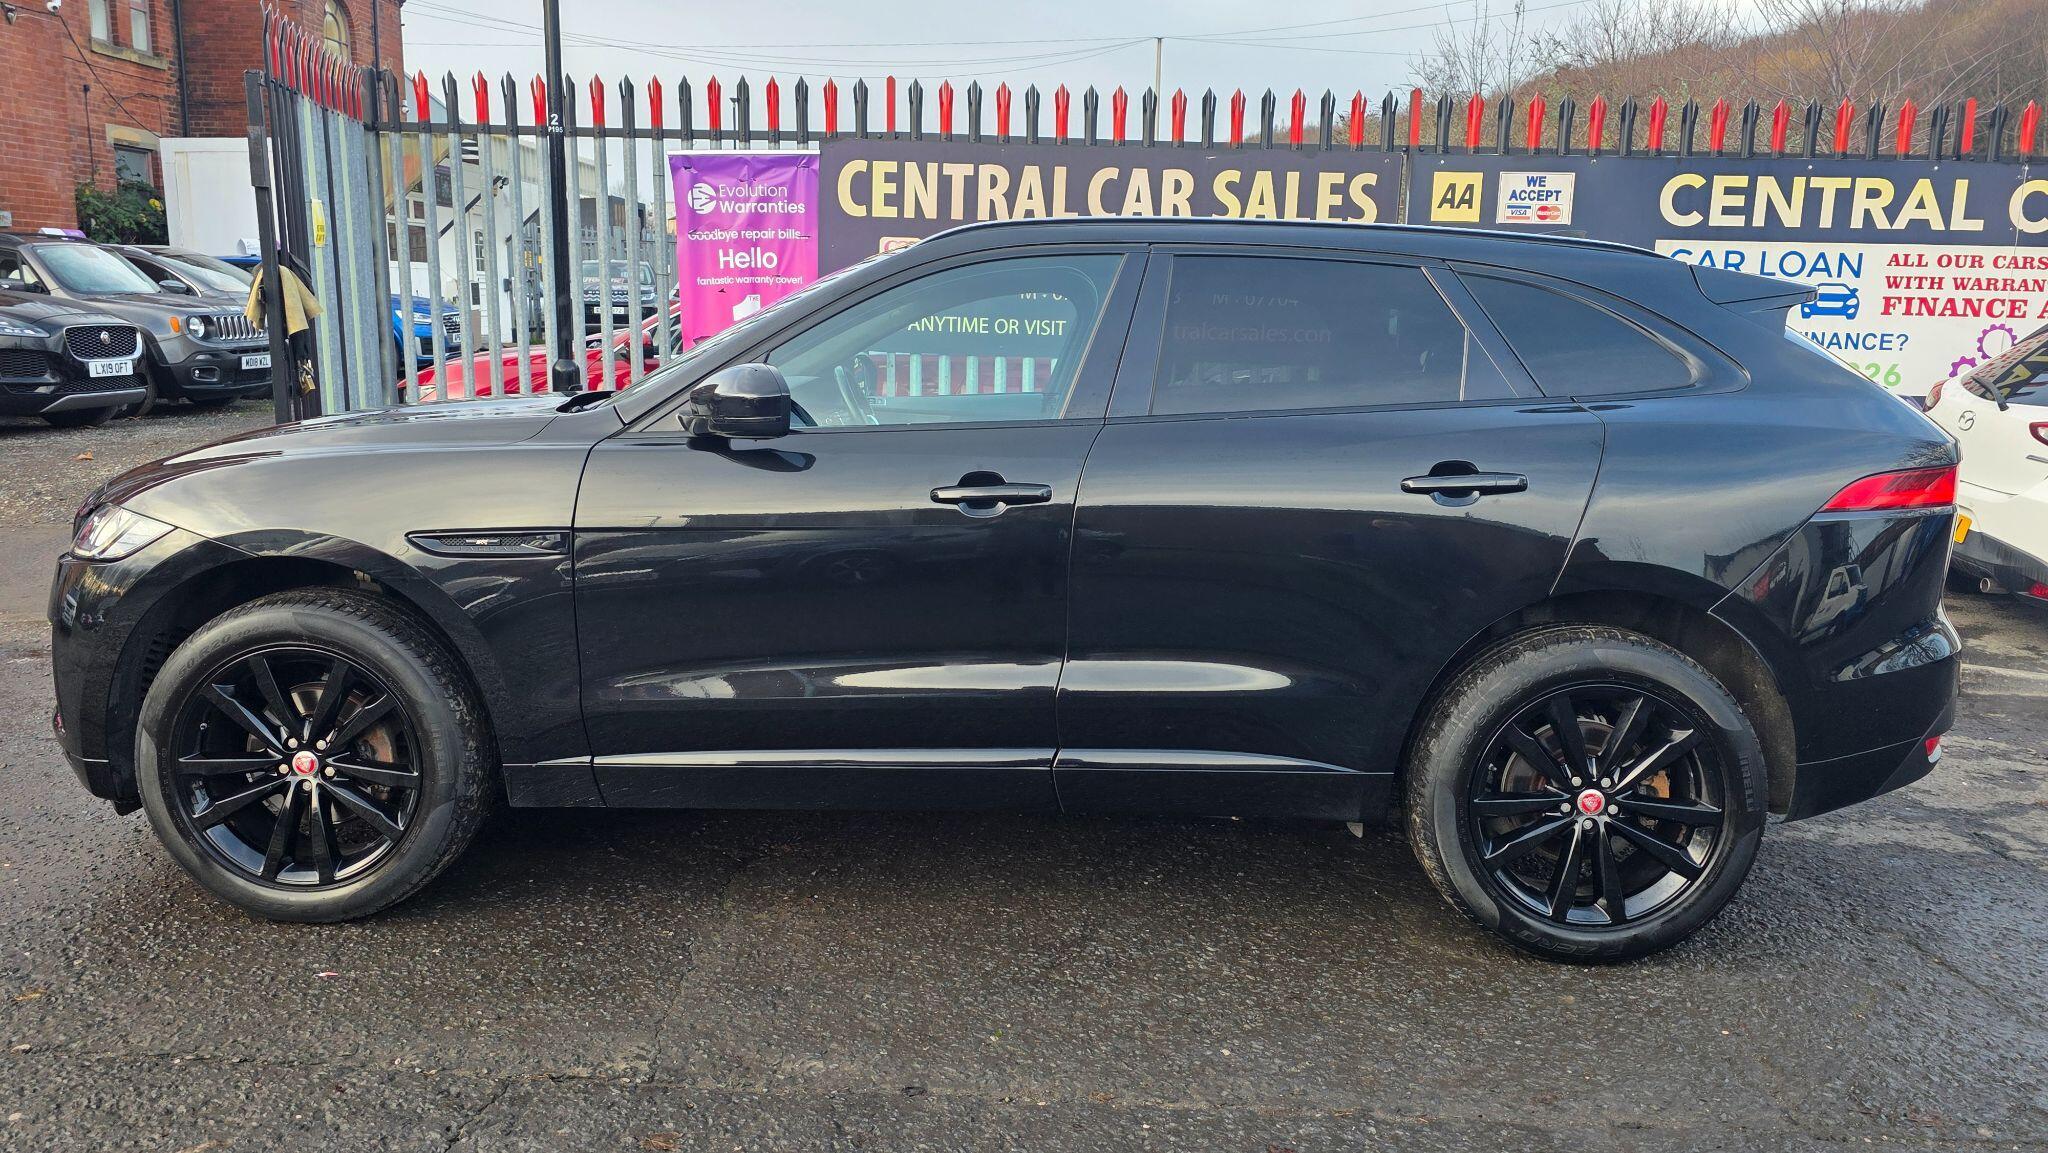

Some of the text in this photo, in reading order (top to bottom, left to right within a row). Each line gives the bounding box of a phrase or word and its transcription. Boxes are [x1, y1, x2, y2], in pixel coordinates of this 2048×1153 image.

[550, 113, 559, 126] 2
[1526, 175, 1547, 188] WE
[718, 183, 788, 199] Evolution
[836, 158, 1379, 224] CENTRAL CAR SALES
[1436, 182, 1475, 210] AA
[1508, 189, 1562, 202] ACCEPT
[718, 200, 806, 214] Warranties
[1659, 172, 2048, 234] CENTRAL C
[688, 228, 739, 242] Goodbye
[741, 228, 776, 242] repair
[718, 246, 778, 270] Hello
[1760, 250, 1865, 279] LOAN
[1886, 253, 2048, 271] ALL OUR CARS
[697, 276, 803, 286] fantastic warranty cover!
[1885, 275, 1946, 291] WITH
[1880, 296, 2029, 319] FINANCE
[907, 315, 1067, 336] ANYTIME OR VISIT
[1799, 331, 1909, 351] NANCE?
[95, 361, 128, 375] LX19 OFT
